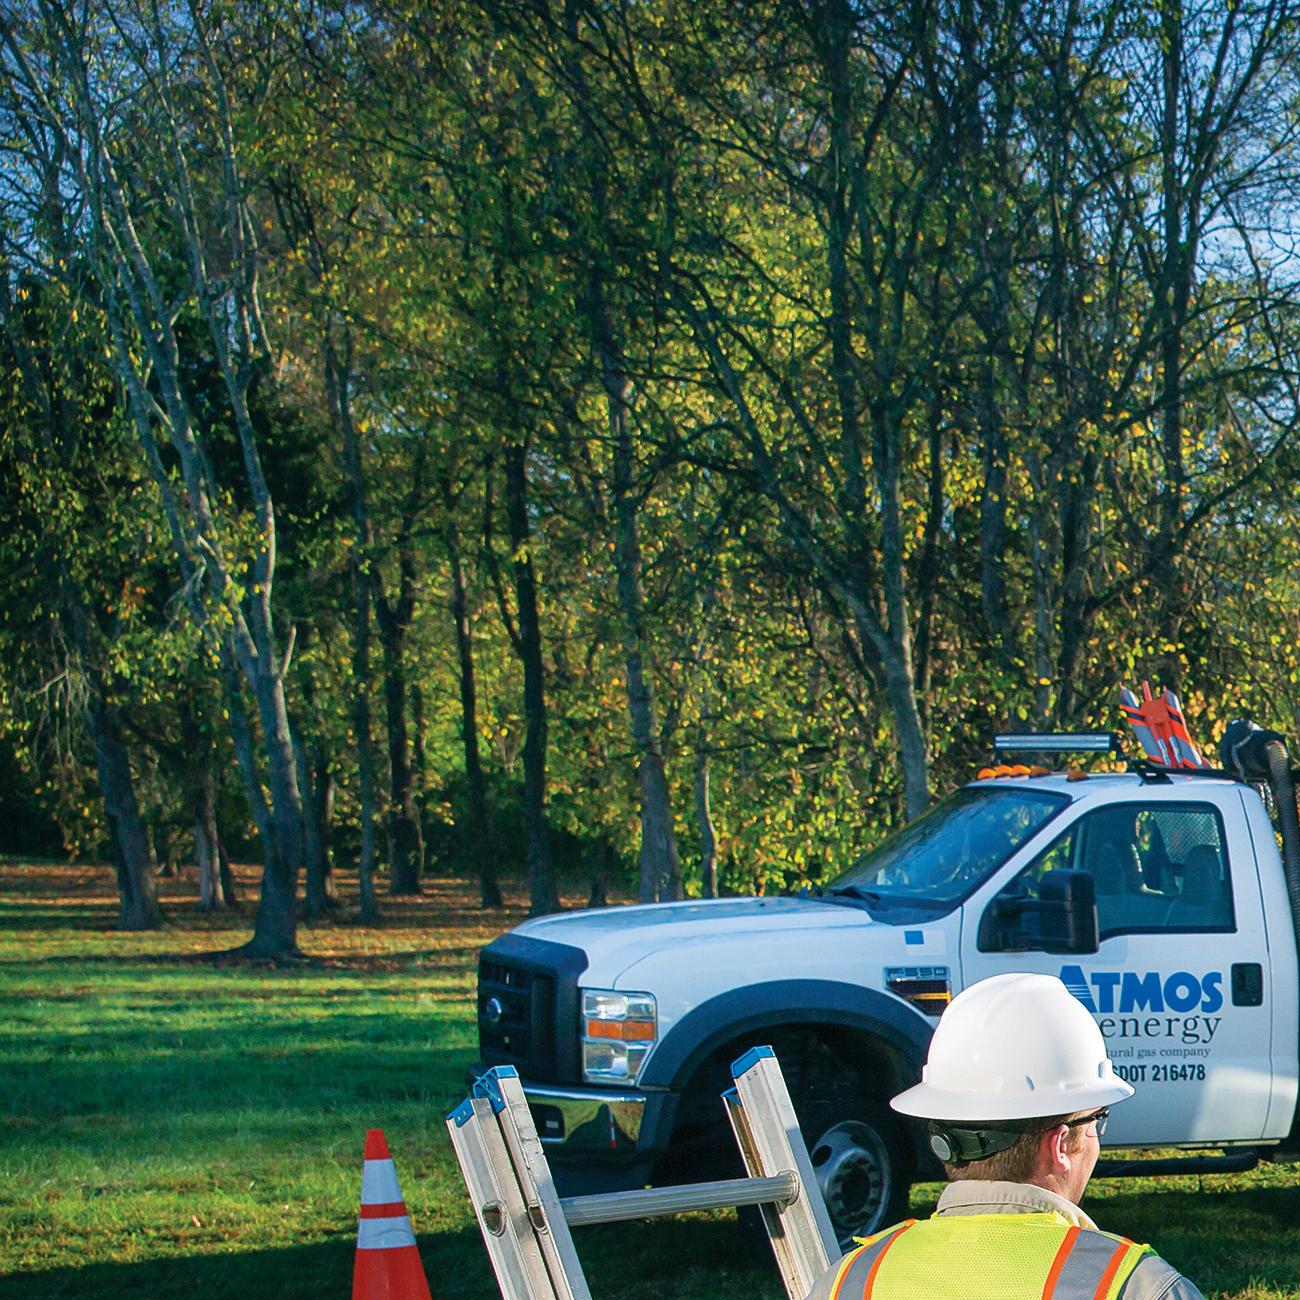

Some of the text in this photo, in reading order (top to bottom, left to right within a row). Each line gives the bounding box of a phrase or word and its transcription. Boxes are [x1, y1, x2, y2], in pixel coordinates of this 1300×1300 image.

[1100, 1015, 1222, 1045] energy
[1137, 1049, 1157, 1059] gas
[1160, 1048, 1211, 1059] company
[1152, 1064, 1206, 1082] 216478
